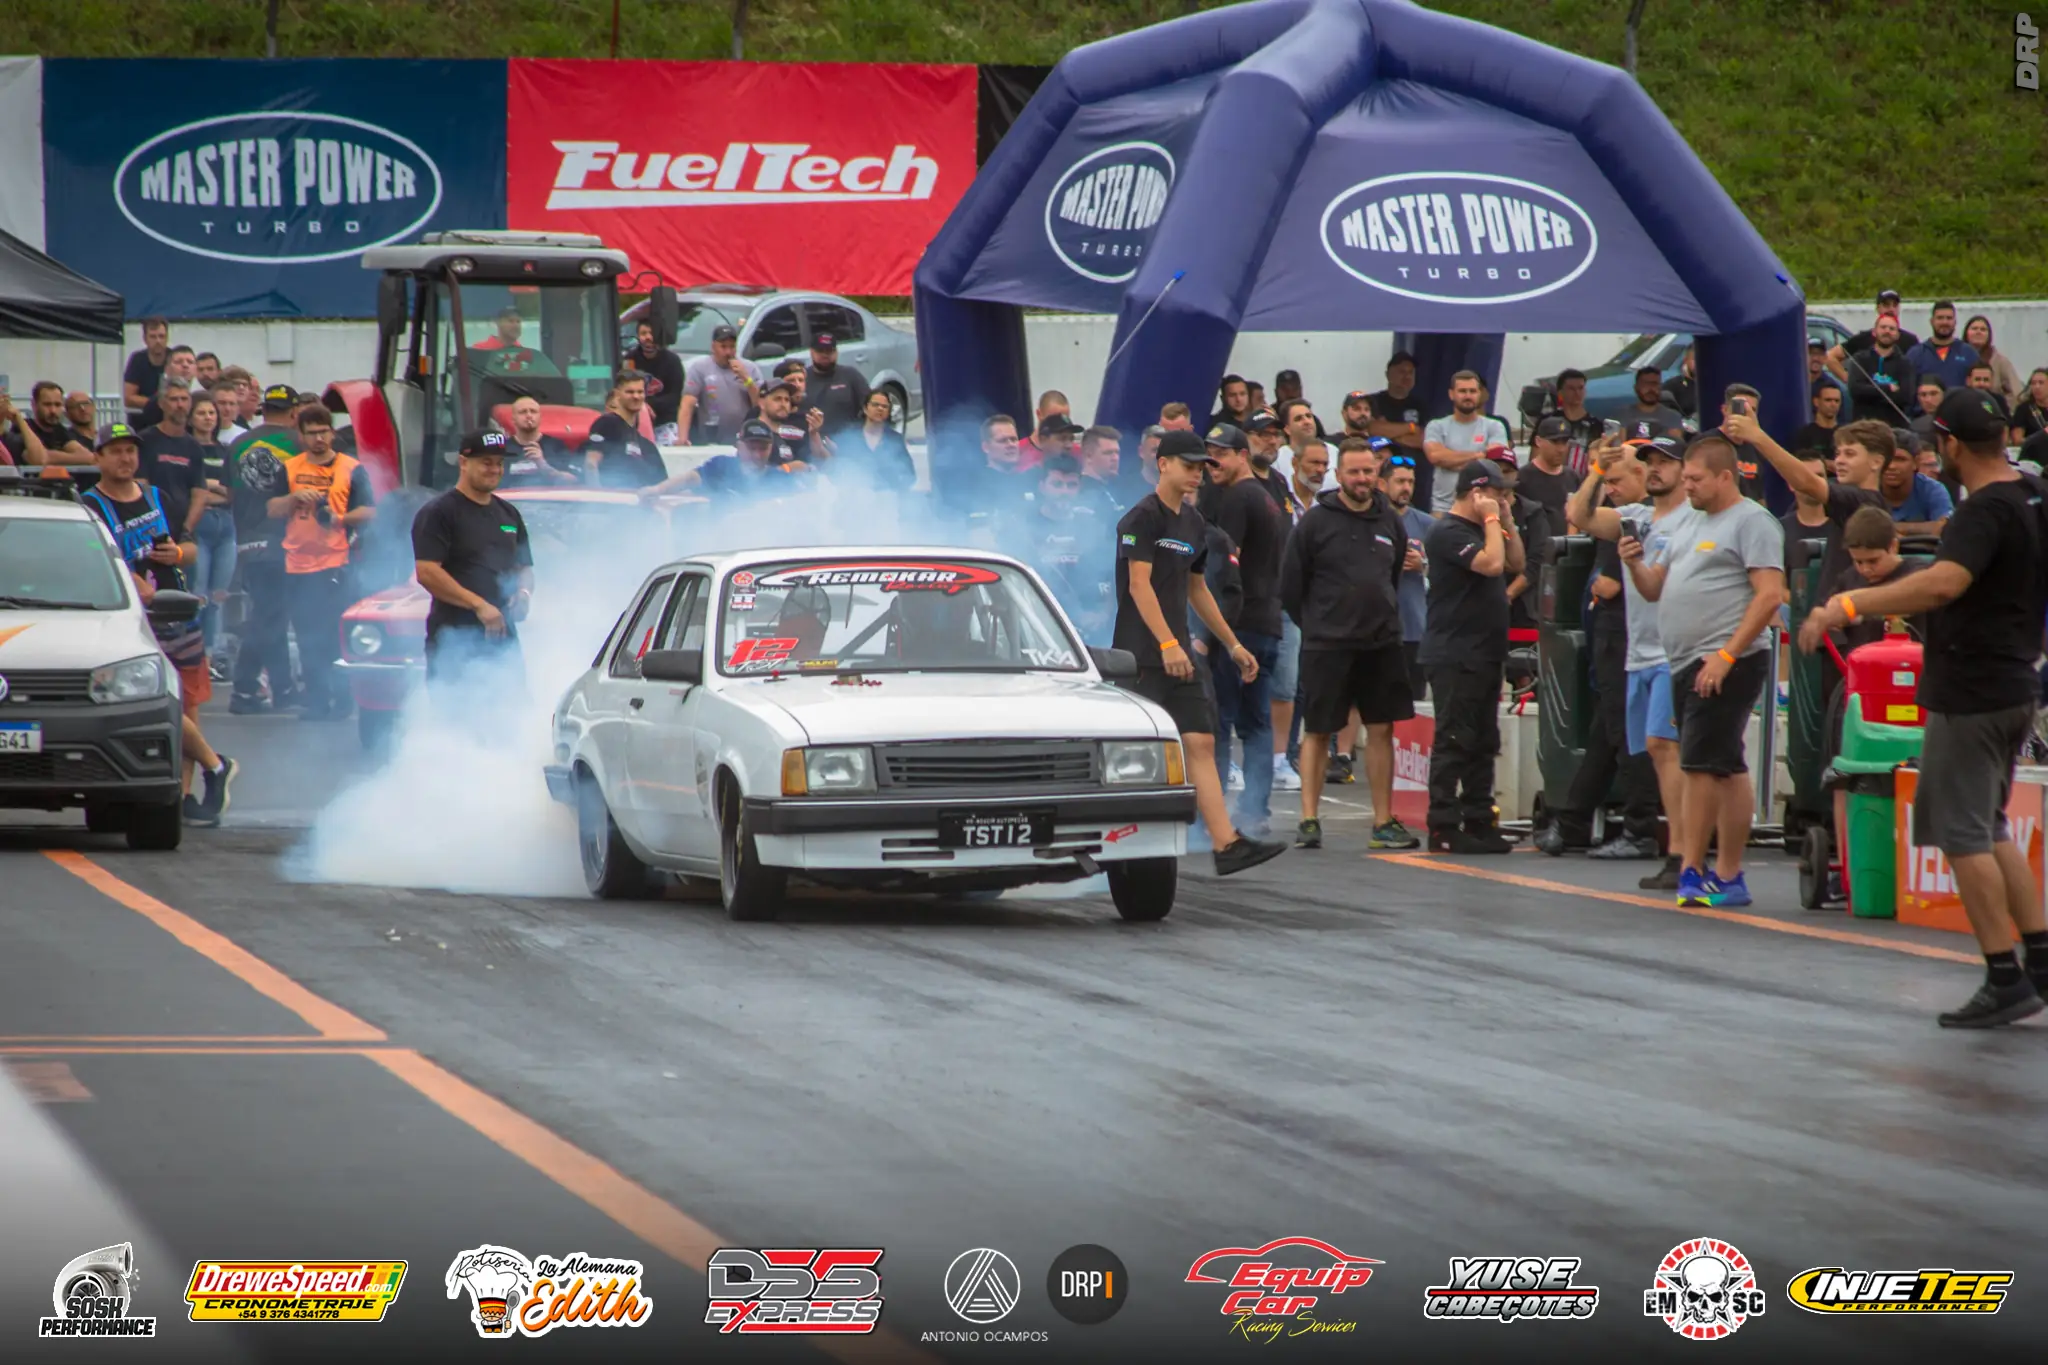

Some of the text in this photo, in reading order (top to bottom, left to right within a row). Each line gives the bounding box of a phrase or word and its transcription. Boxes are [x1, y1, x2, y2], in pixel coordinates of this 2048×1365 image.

[141, 138, 416, 207] MASTER POWER
[551, 141, 939, 200] FuelTech
[1060, 164, 1135, 230] MASTER
[201, 221, 360, 234] TURBO
[1341, 194, 1573, 254] MASTER POWER
[1397, 267, 1531, 279] TURBO
[808, 571, 957, 585] REMOKAR
[728, 637, 799, 667] 12
